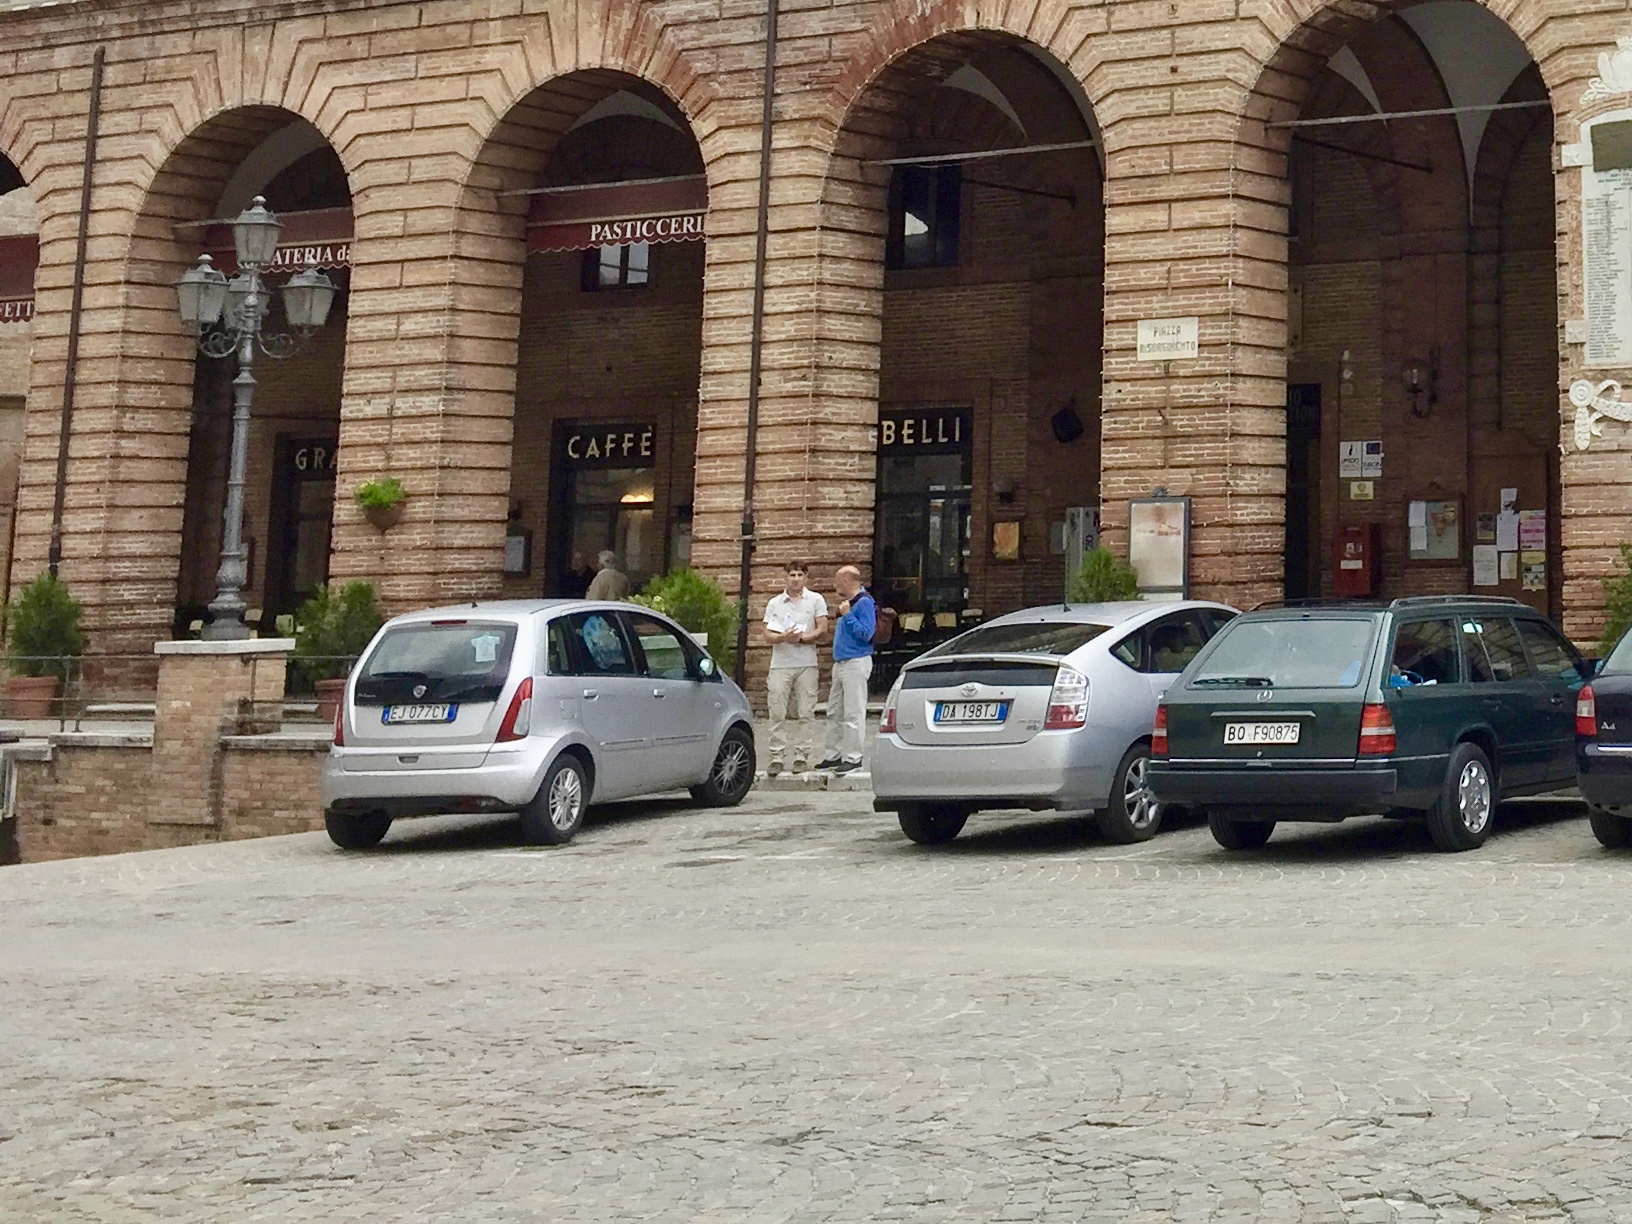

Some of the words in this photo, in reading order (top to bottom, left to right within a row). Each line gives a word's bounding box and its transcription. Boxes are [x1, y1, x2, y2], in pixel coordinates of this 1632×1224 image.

[881, 416, 961, 445] BELLI
[390, 706, 406, 719] EJ
[408, 705, 448, 719] 077CY
[942, 704, 956, 718] DA
[962, 703, 998, 718] 198TJ
[1253, 725, 1299, 740] F90875
